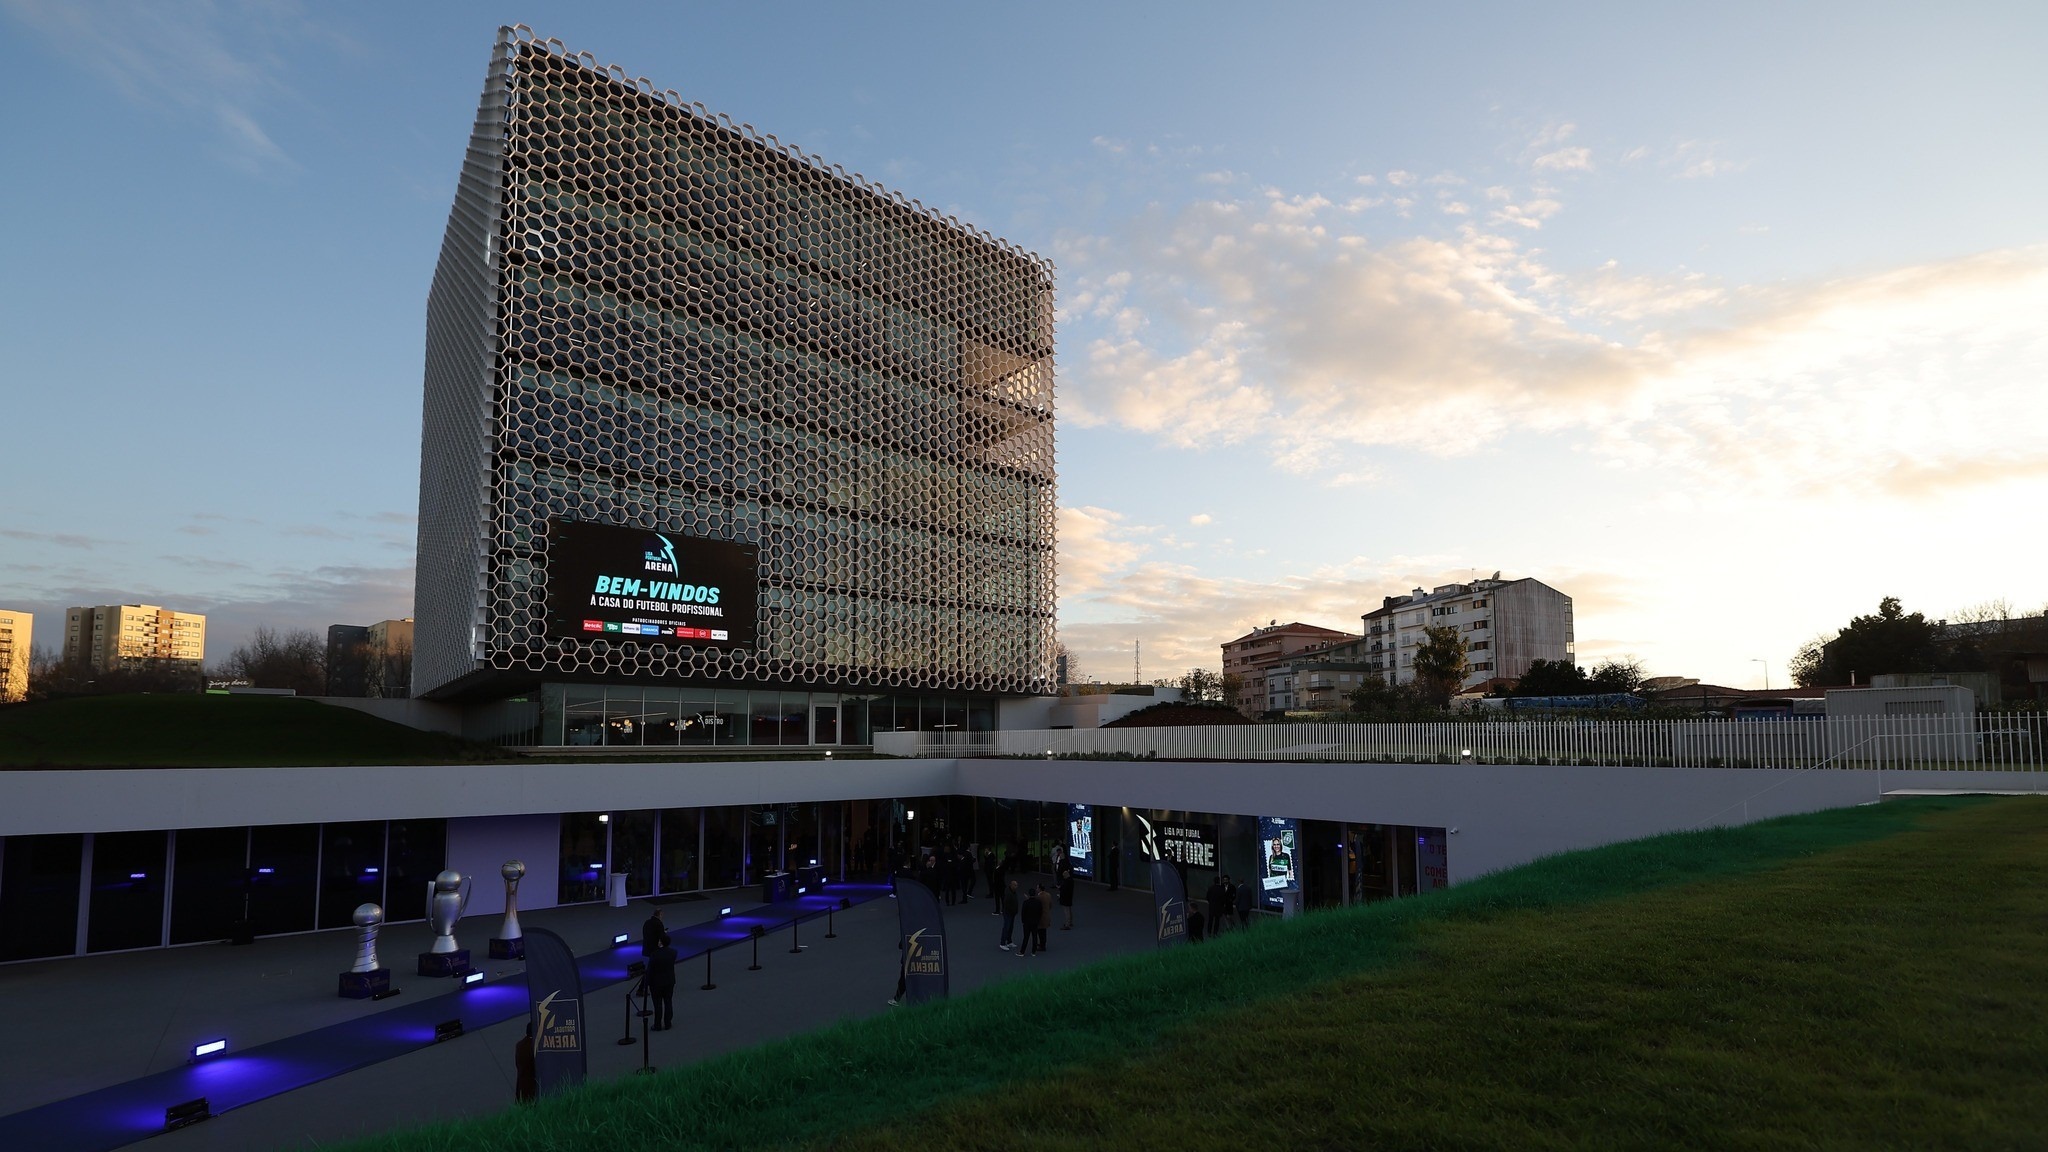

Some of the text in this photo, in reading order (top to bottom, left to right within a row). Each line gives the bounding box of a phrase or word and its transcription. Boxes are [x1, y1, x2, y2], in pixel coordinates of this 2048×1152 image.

[644, 561, 673, 573] ARENA
[595, 575, 720, 604] BEM-VINDOS
[598, 596, 621, 609] CASA
[623, 598, 634, 610] DO
[636, 600, 670, 613] FUTEBOL
[671, 603, 724, 617] PROFISSIONAL
[632, 617, 668, 625] PATROCINADORES
[208, 680, 230, 689] pingo
[1164, 826, 1201, 839] LIGA POTUGAL
[1164, 839, 1215, 867] STORE
